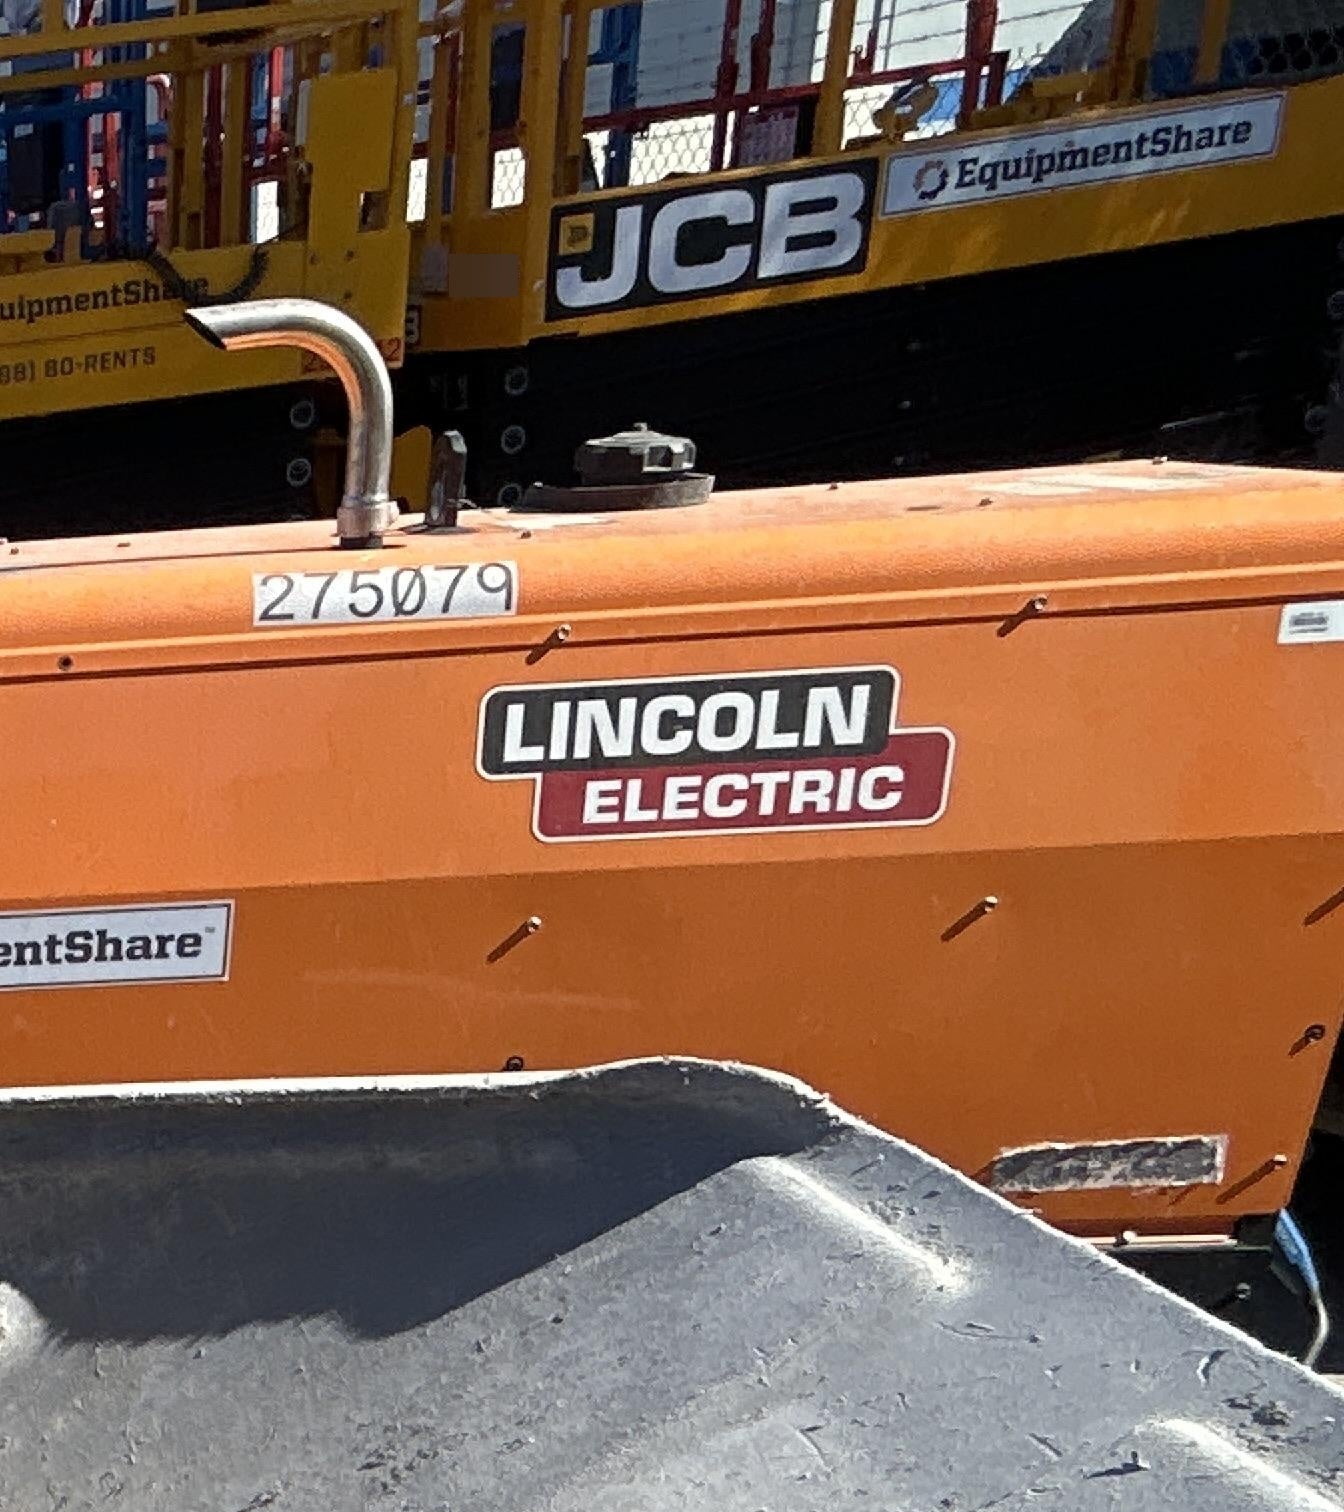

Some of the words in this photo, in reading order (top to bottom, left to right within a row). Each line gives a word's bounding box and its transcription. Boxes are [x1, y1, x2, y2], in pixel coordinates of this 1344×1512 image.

[954, 118, 1254, 193] EquipmentShare
[554, 171, 866, 309] JCB
[257, 562, 515, 622] 275079
[501, 684, 872, 765] LINCOLN
[581, 763, 906, 825] ELECTRIC
